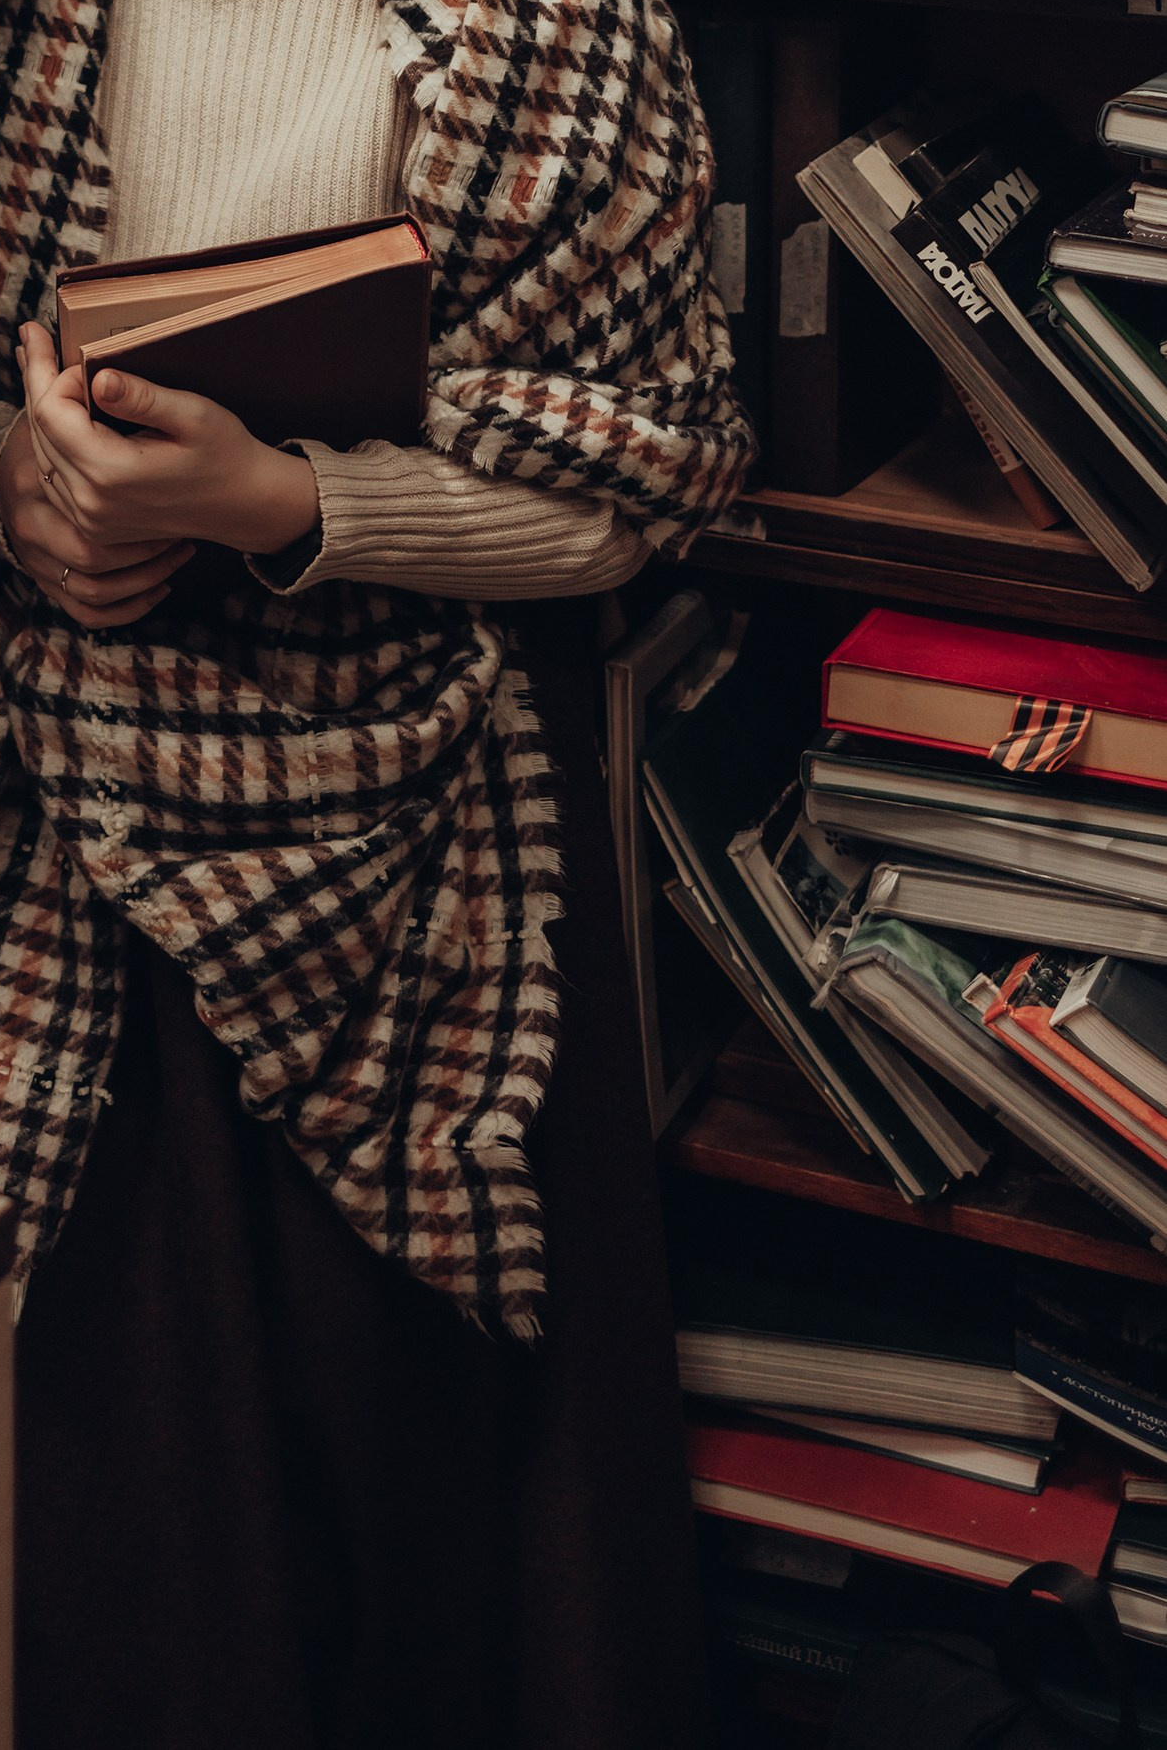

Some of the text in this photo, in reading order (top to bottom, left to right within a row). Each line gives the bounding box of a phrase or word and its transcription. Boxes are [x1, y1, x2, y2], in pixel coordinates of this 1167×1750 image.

[916, 240, 994, 324] ЛАДОГА
[1062, 1376, 1167, 1428] ДОСТОПРИМЕ
[1137, 1419, 1167, 1440] КУЛ
